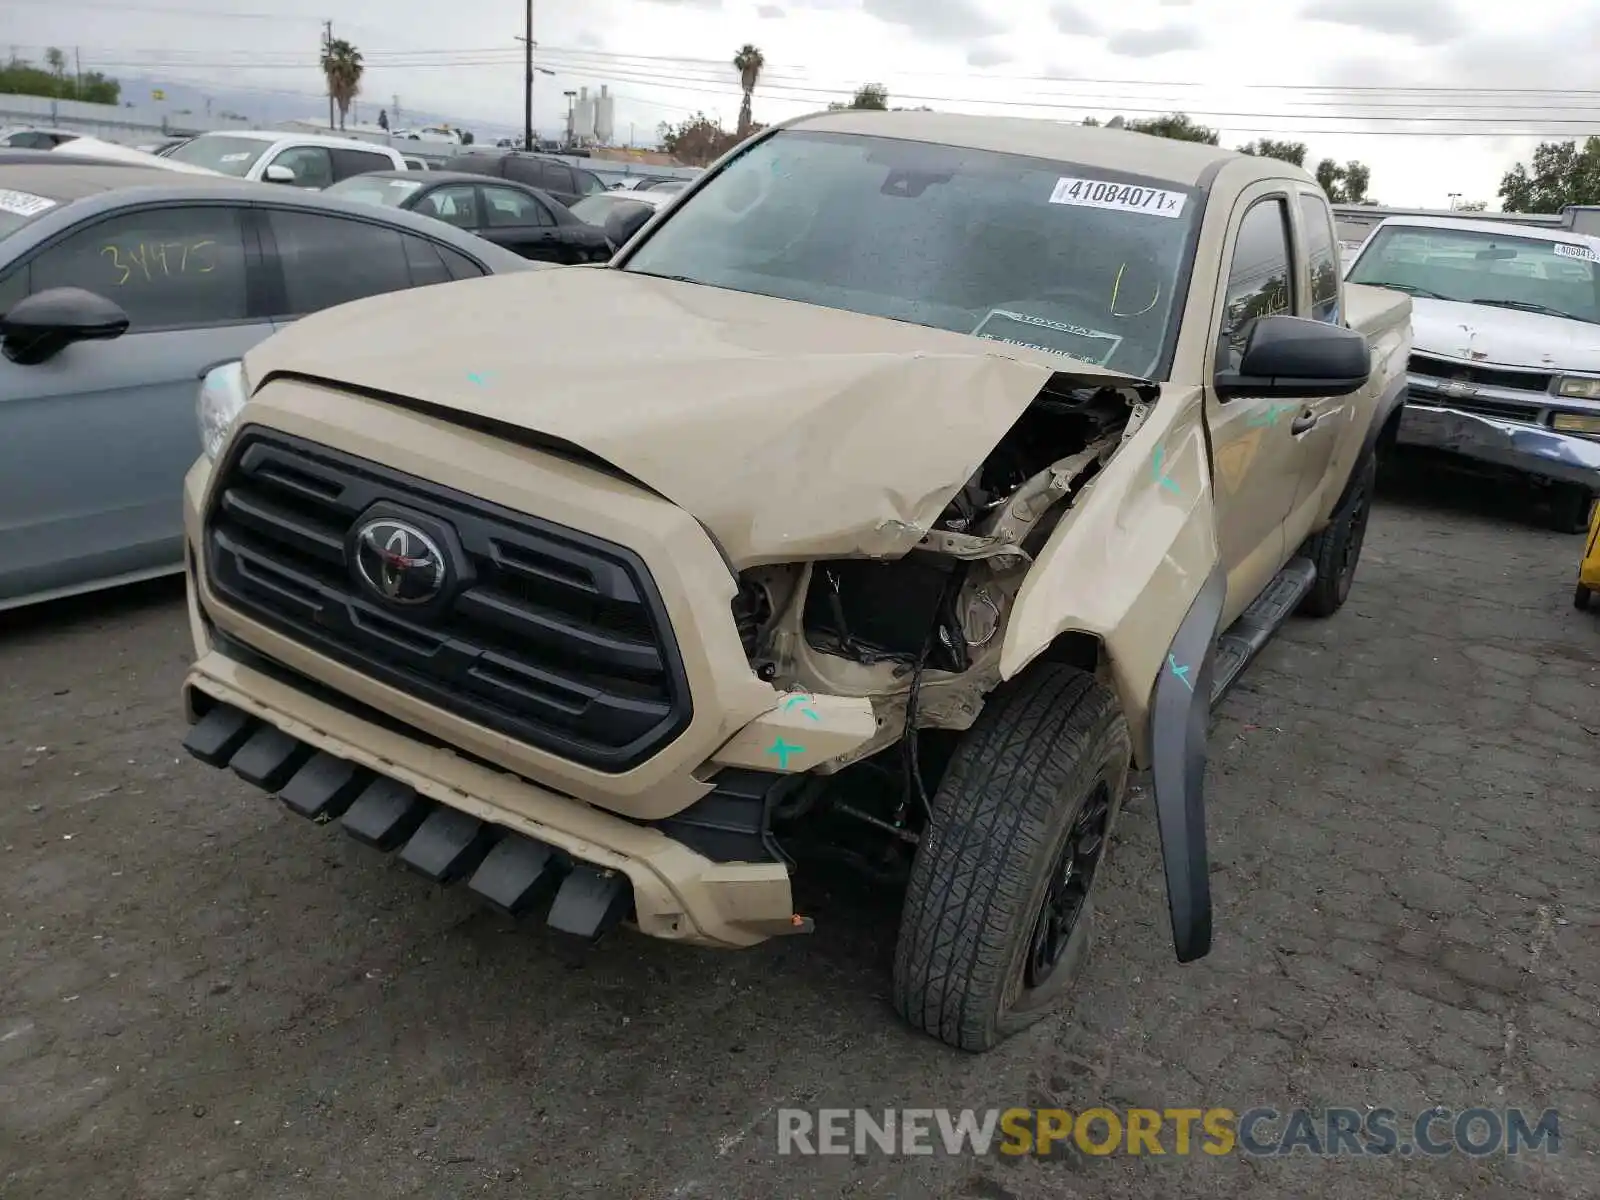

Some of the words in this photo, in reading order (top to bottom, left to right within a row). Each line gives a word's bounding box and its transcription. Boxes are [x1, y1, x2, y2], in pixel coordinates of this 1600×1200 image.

[1068, 180, 1167, 210] 41084071
[100, 240, 216, 285] 34475
[1561, 245, 1600, 261] 4068413
[1022, 314, 1088, 334] TOYOTA
